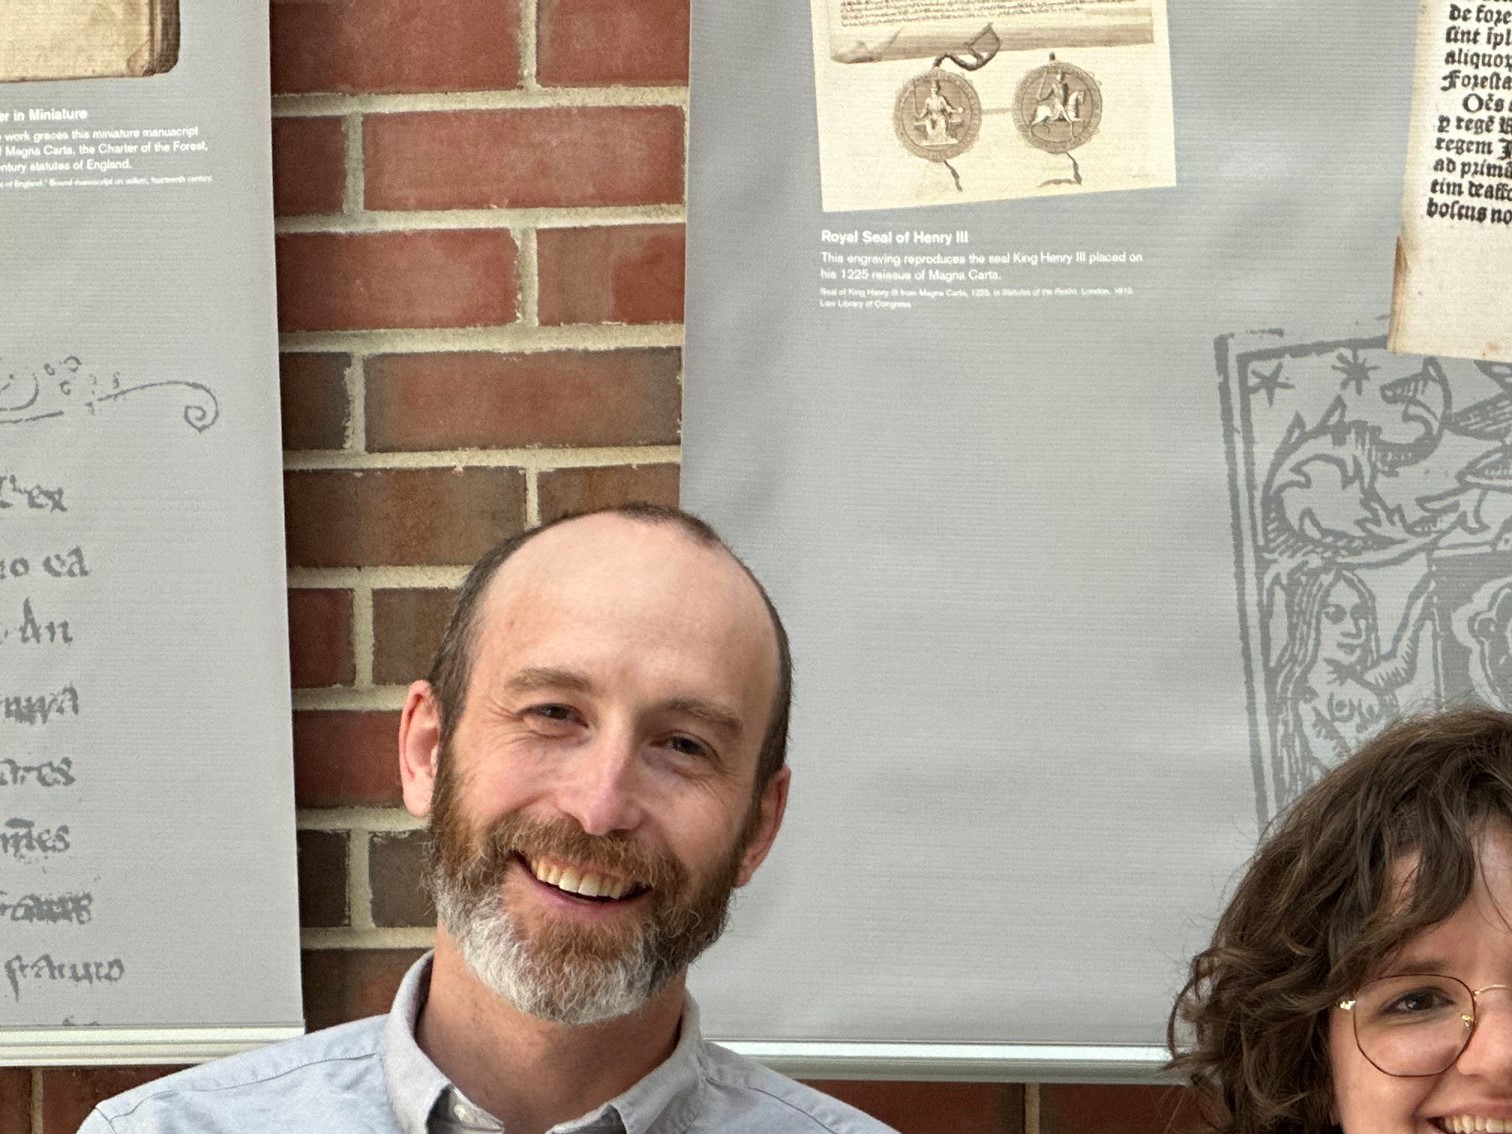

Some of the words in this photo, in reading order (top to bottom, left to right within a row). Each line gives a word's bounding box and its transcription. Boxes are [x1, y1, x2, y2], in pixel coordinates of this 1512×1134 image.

[13, 109, 25, 121] in
[29, 108, 88, 121] Miniature
[5, 130, 30, 142] work
[33, 132, 69, 143] graces
[71, 129, 90, 140] this
[92, 129, 140, 139] miniature
[142, 126, 199, 138] manuscript
[5, 145, 41, 159] Magna
[43, 144, 76, 156] Carta,
[79, 144, 96, 155] the
[98, 143, 138, 154] Charter
[140, 141, 151, 153] of
[154, 141, 171, 152] the
[173, 140, 208, 152] Forest,
[30, 161, 70, 172] statutes
[73, 160, 83, 170] of
[86, 158, 132, 172] England.
[821, 229, 858, 245] Royal
[862, 230, 893, 244] Seal
[895, 231, 910, 244] of
[913, 231, 952, 246] Henry
[956, 230, 969, 243] III
[821, 251, 844, 264] This
[847, 253, 900, 267] engraving
[903, 253, 966, 267] reproduces
[968, 253, 985, 264] the
[989, 252, 1010, 264] seal
[1013, 252, 1038, 265] King
[1040, 252, 1072, 265] Henry
[1076, 251, 1086, 262] III
[1089, 251, 1126, 265] placed
[1129, 253, 1143, 263] on
[820, 268, 837, 280] his
[842, 268, 869, 280] 1225
[872, 269, 911, 281] reissue
[914, 269, 926, 280] of
[928, 269, 965, 283] Magna
[968, 269, 1001, 280] Carta.
